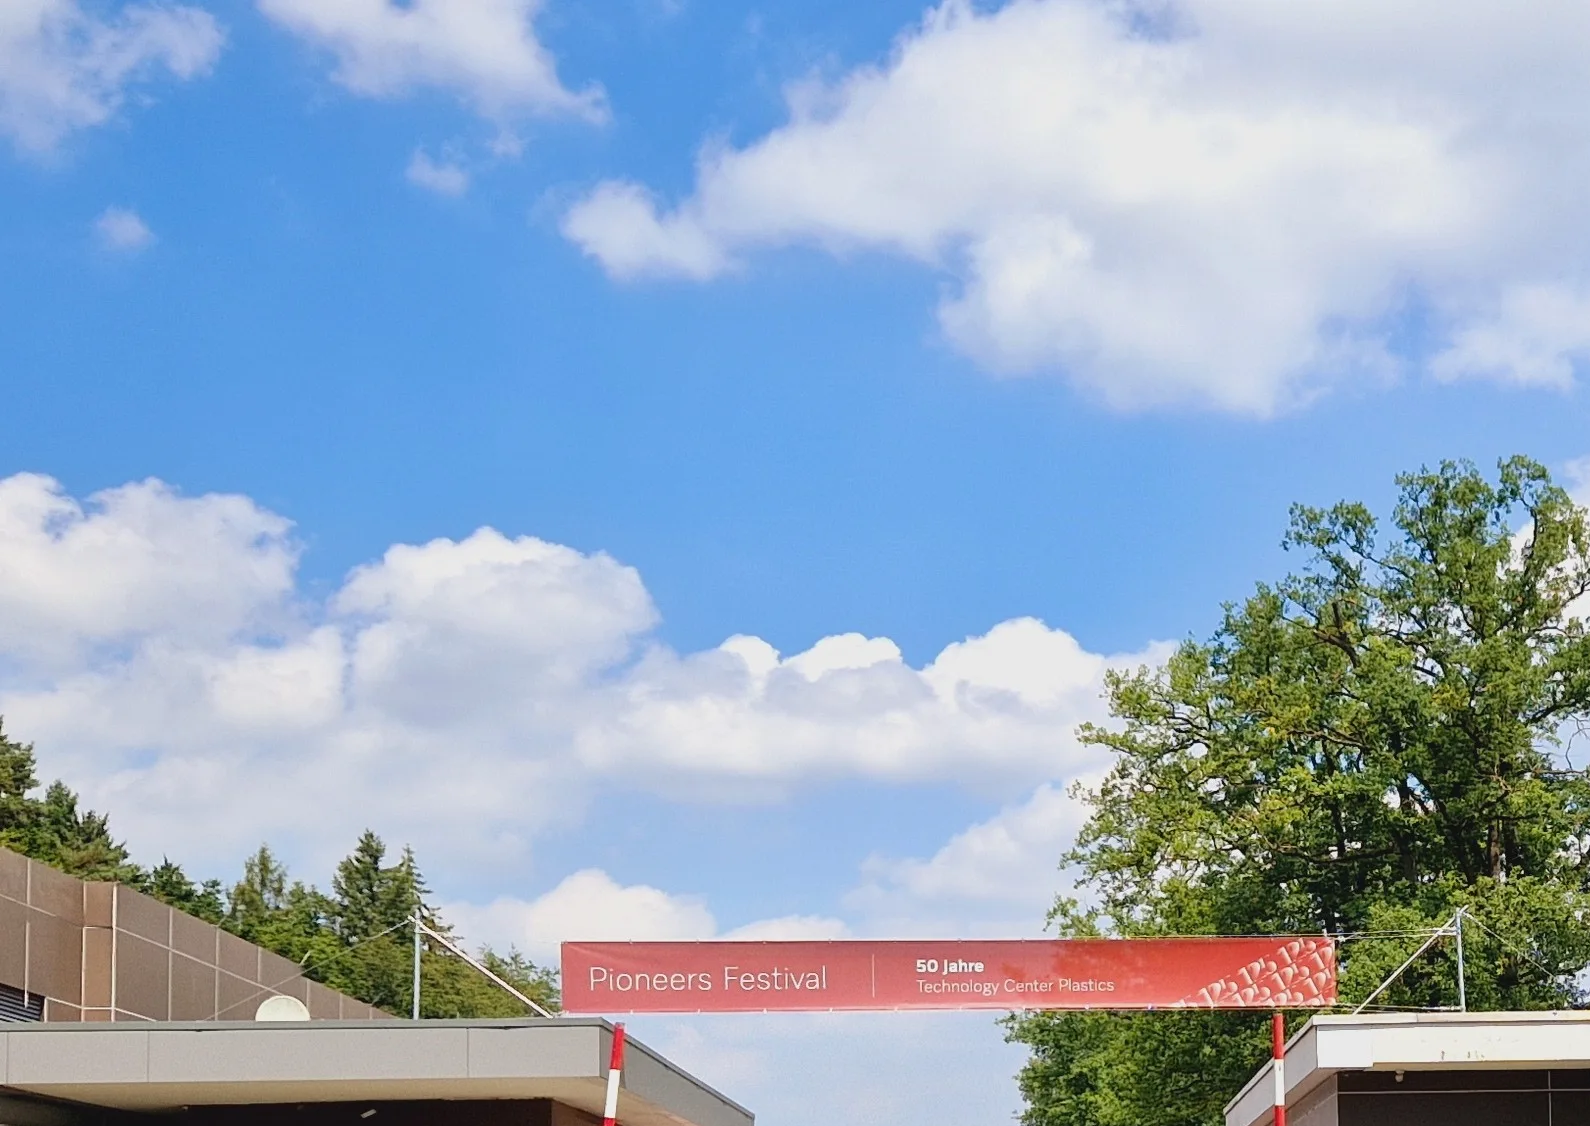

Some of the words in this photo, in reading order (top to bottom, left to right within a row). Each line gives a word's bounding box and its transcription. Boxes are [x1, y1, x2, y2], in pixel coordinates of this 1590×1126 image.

[916, 959, 938, 973] 50
[942, 959, 984, 975] Jahre
[589, 966, 712, 991] Pioneers
[724, 965, 827, 990] Festival
[916, 979, 999, 996] Technology
[1004, 979, 1053, 993] Center
[1059, 978, 1115, 993] Plastics
